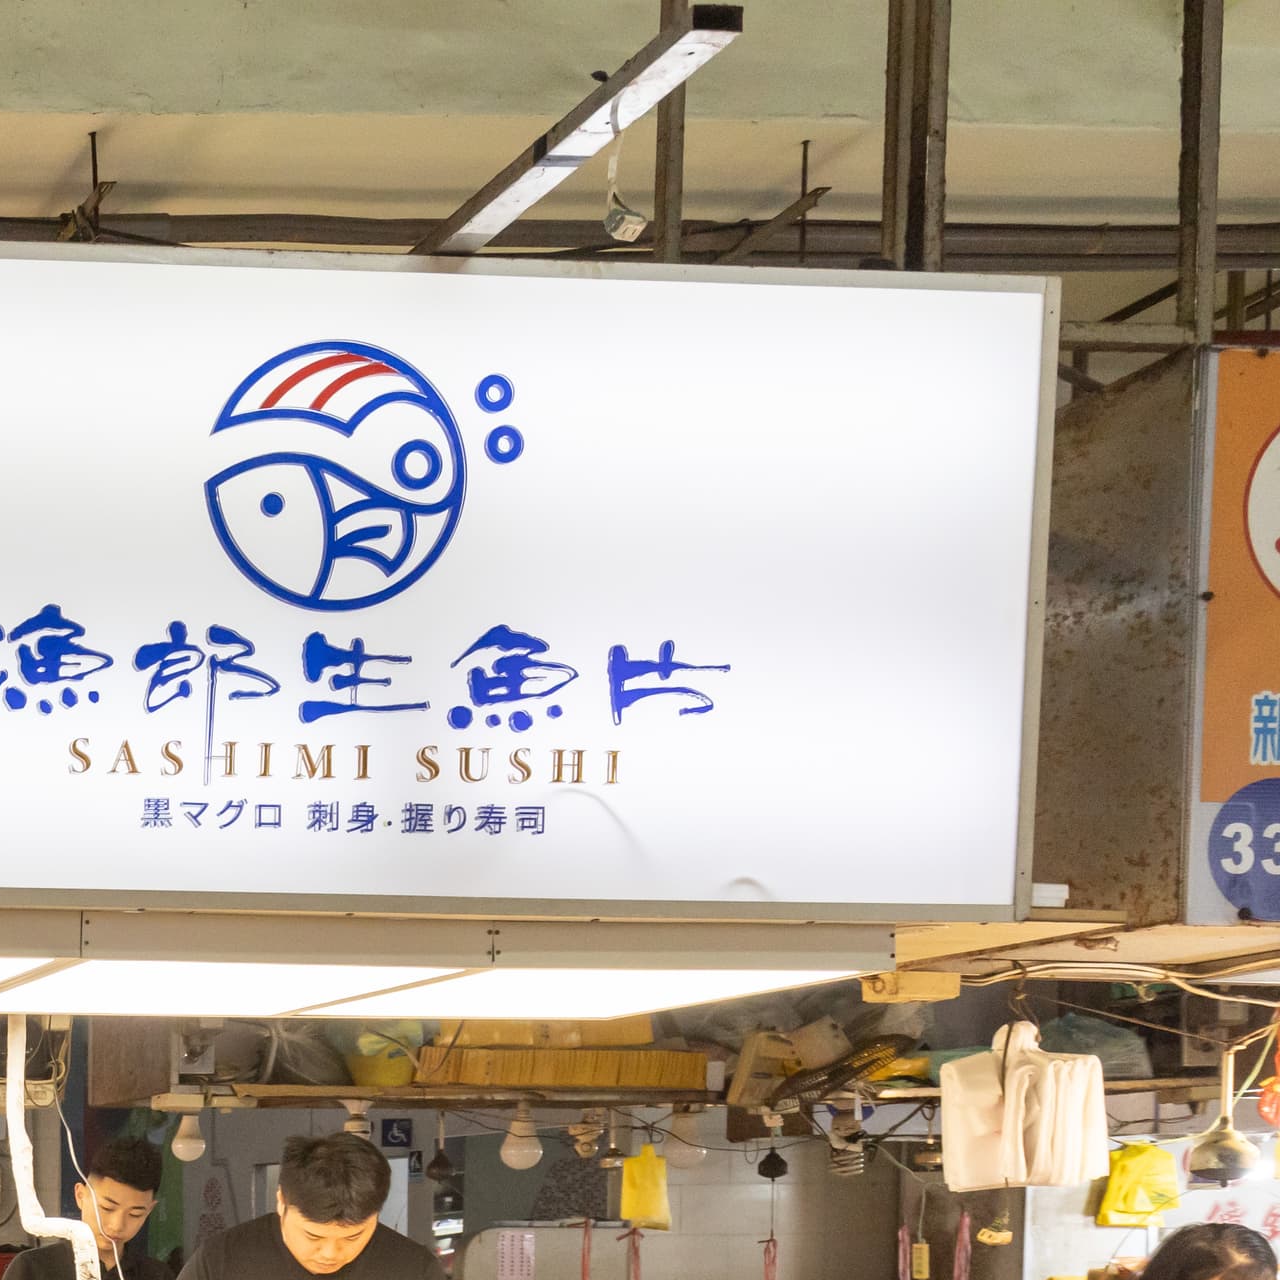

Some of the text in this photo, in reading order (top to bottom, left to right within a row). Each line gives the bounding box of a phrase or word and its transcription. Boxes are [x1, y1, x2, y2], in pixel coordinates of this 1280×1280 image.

[68, 737, 622, 786] SASHIMI SUSHI
[140, 798, 282, 828] 黒マグロ
